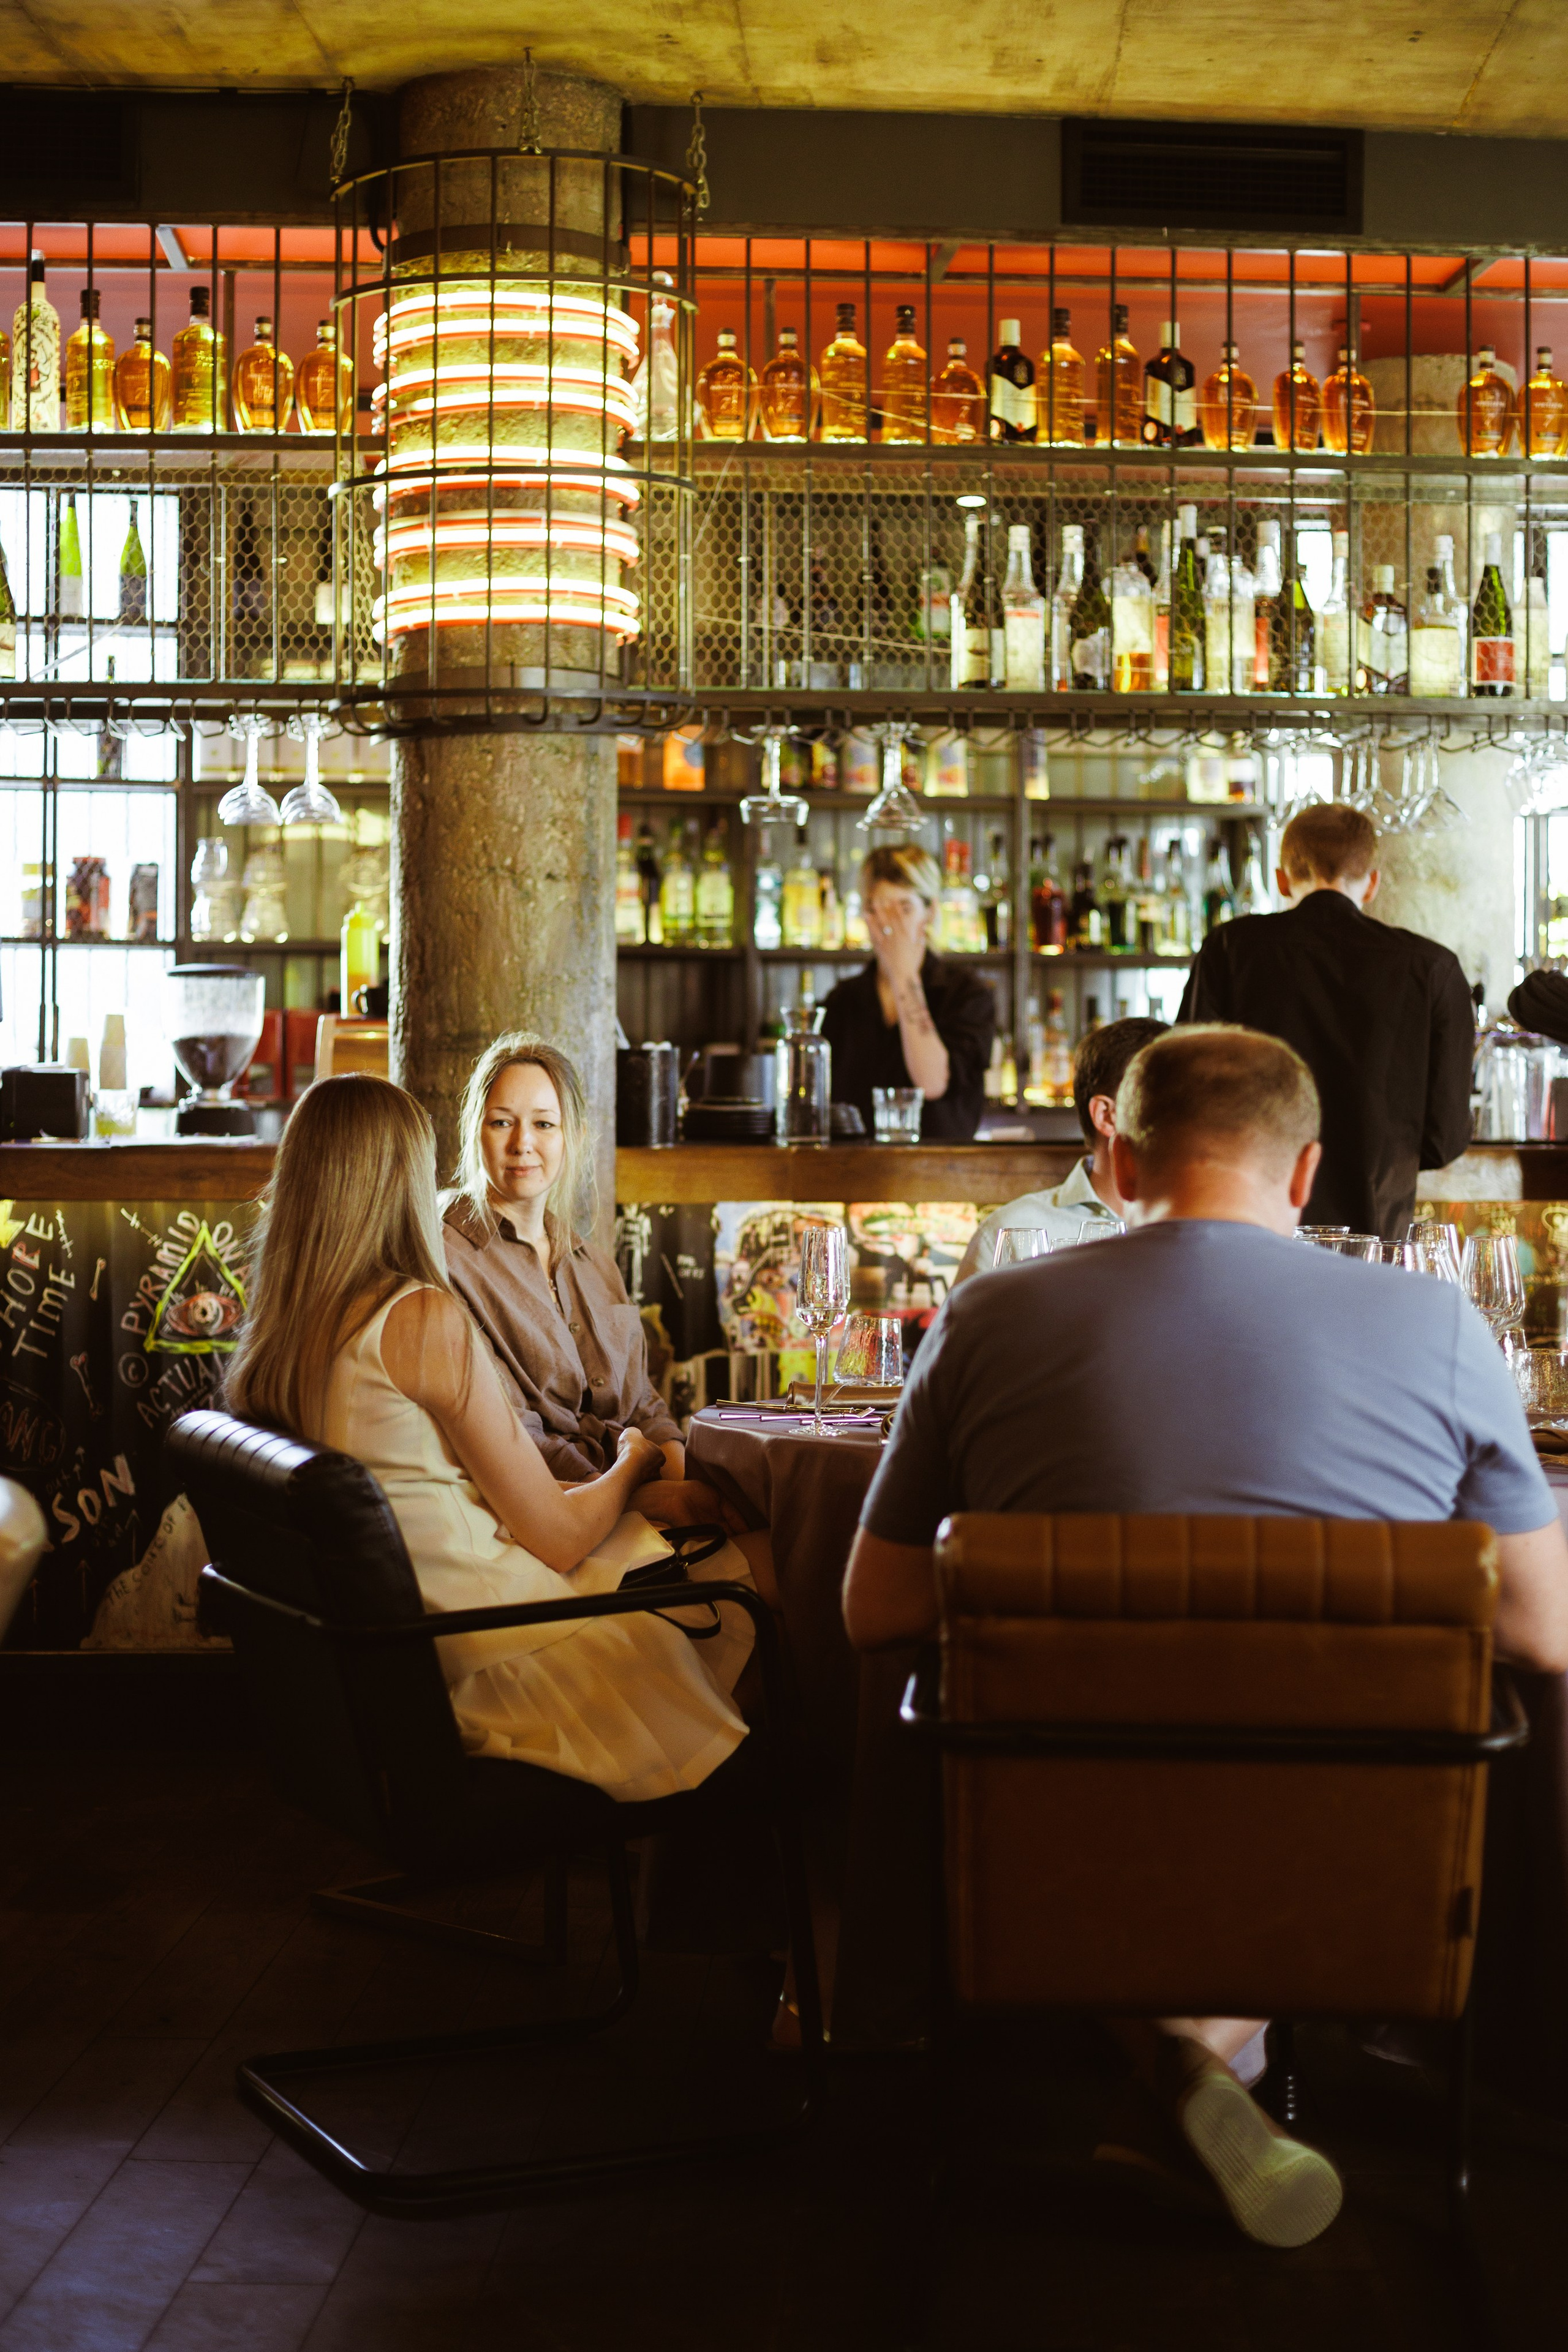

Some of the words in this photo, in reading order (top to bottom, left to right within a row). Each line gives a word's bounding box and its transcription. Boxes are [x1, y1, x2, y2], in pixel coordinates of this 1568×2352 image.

[11, 1262, 76, 1359] TIME
[119, 1210, 200, 1336] PYRAMID
[51, 1452, 137, 1545] SON
